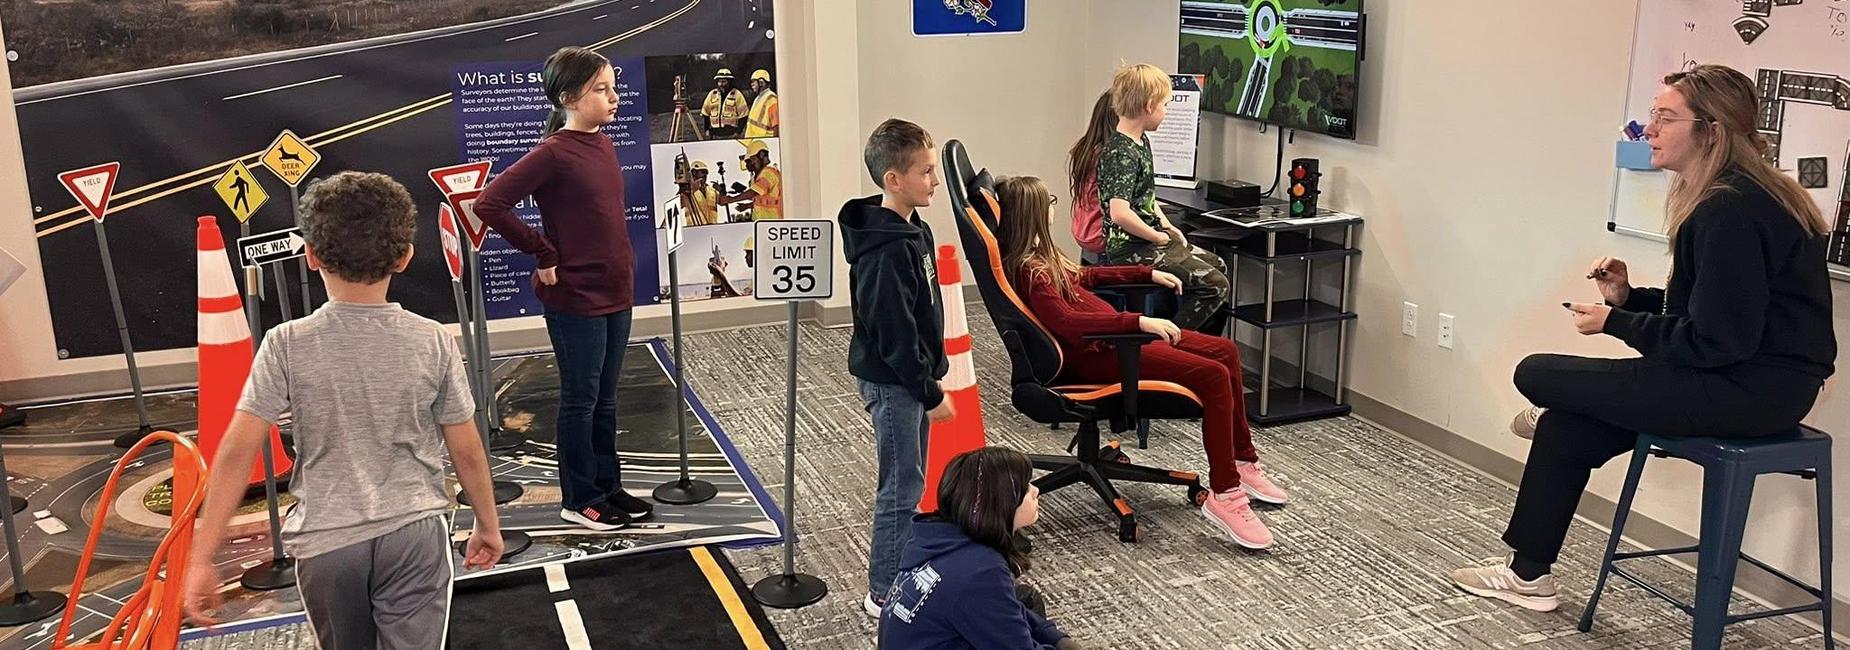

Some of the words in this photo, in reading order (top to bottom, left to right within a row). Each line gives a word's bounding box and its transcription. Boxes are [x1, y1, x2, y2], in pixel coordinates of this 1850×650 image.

[457, 71, 506, 86] What
[510, 70, 524, 84] is
[461, 88, 493, 96] Surveyors
[517, 95, 532, 103] They
[501, 121, 522, 129] they're
[523, 120, 542, 128] doing
[281, 162, 300, 170] DEER
[83, 177, 101, 187] YIELD
[453, 175, 471, 184] YIELD
[768, 227, 821, 241] SPEED
[247, 244, 268, 257] ONE
[270, 239, 291, 252] WAY
[773, 246, 816, 259] LIMIT
[772, 265, 816, 293] 35
